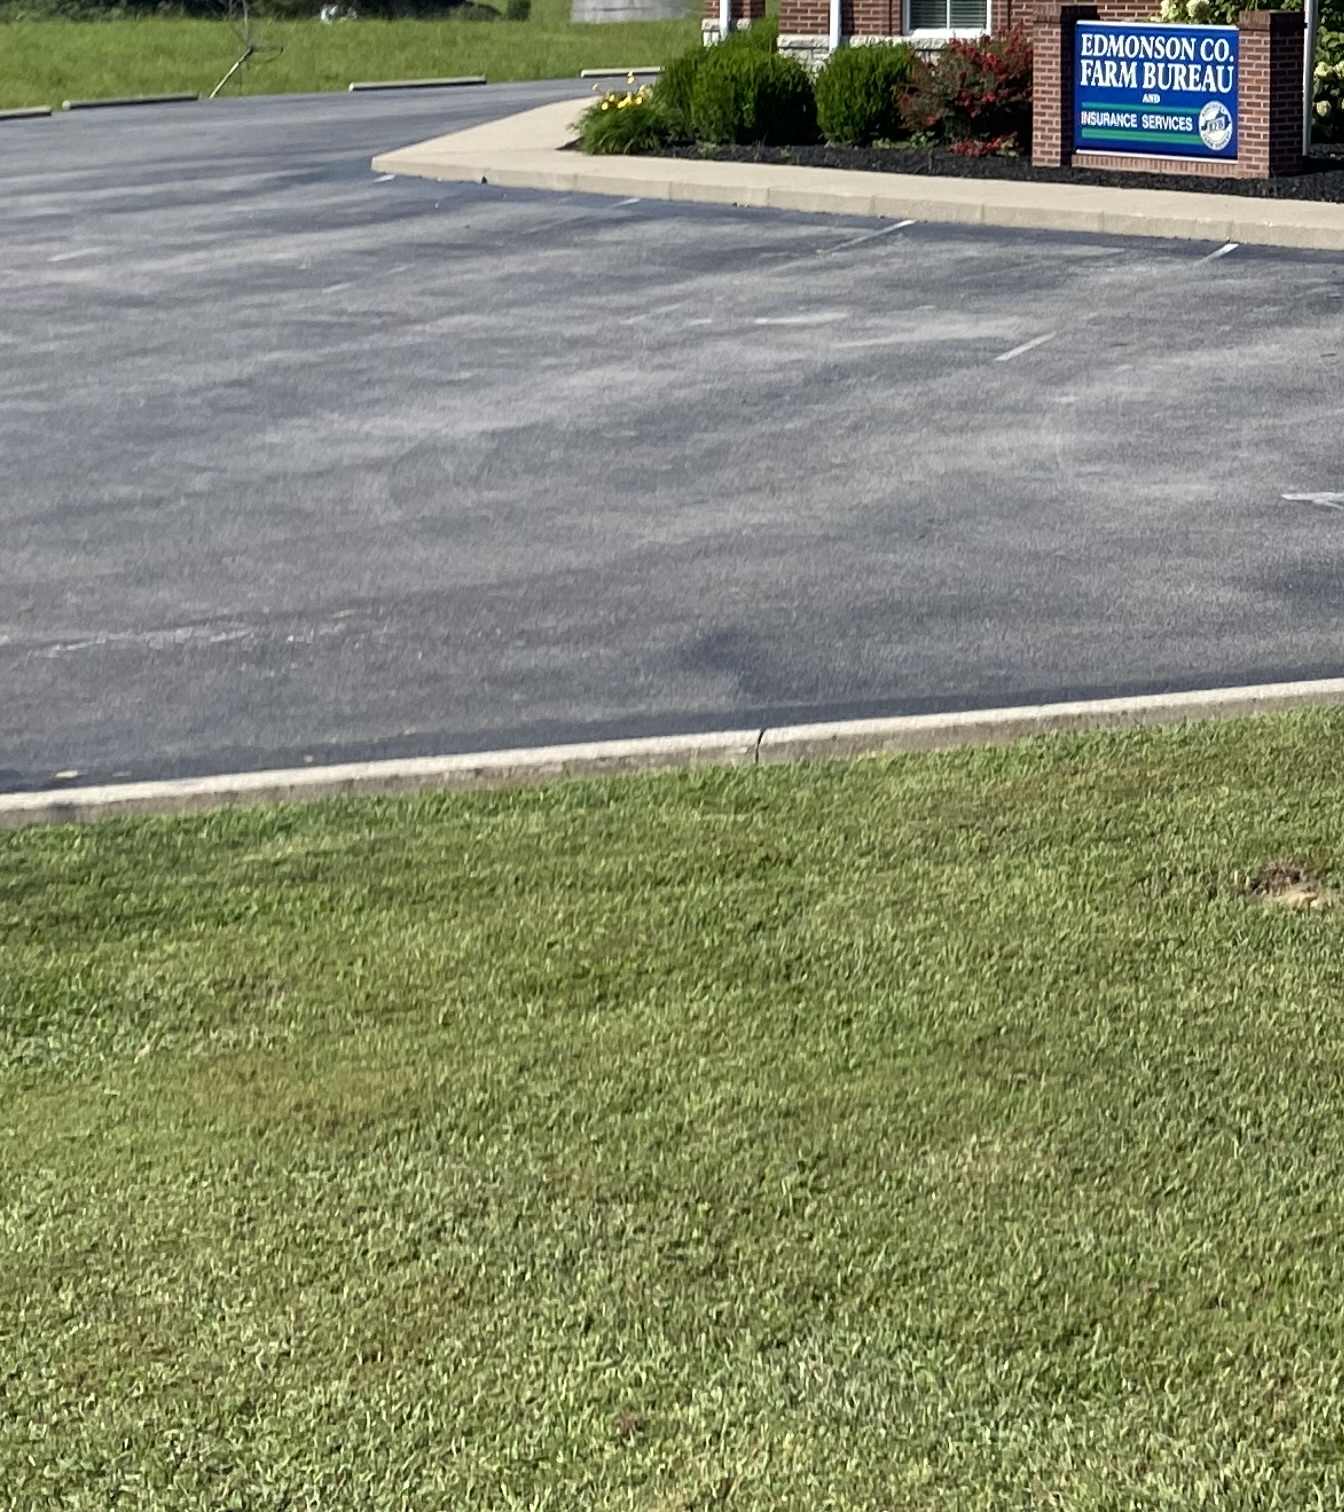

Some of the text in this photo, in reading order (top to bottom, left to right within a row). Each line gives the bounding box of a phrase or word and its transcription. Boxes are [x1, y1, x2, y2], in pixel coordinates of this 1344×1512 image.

[1081, 34, 1234, 63] EDMONSON CO.
[1080, 59, 1234, 93] FARM BUREAU
[1142, 93, 1160, 104] AND
[1080, 111, 1193, 132] INSURANCE SERVICES
